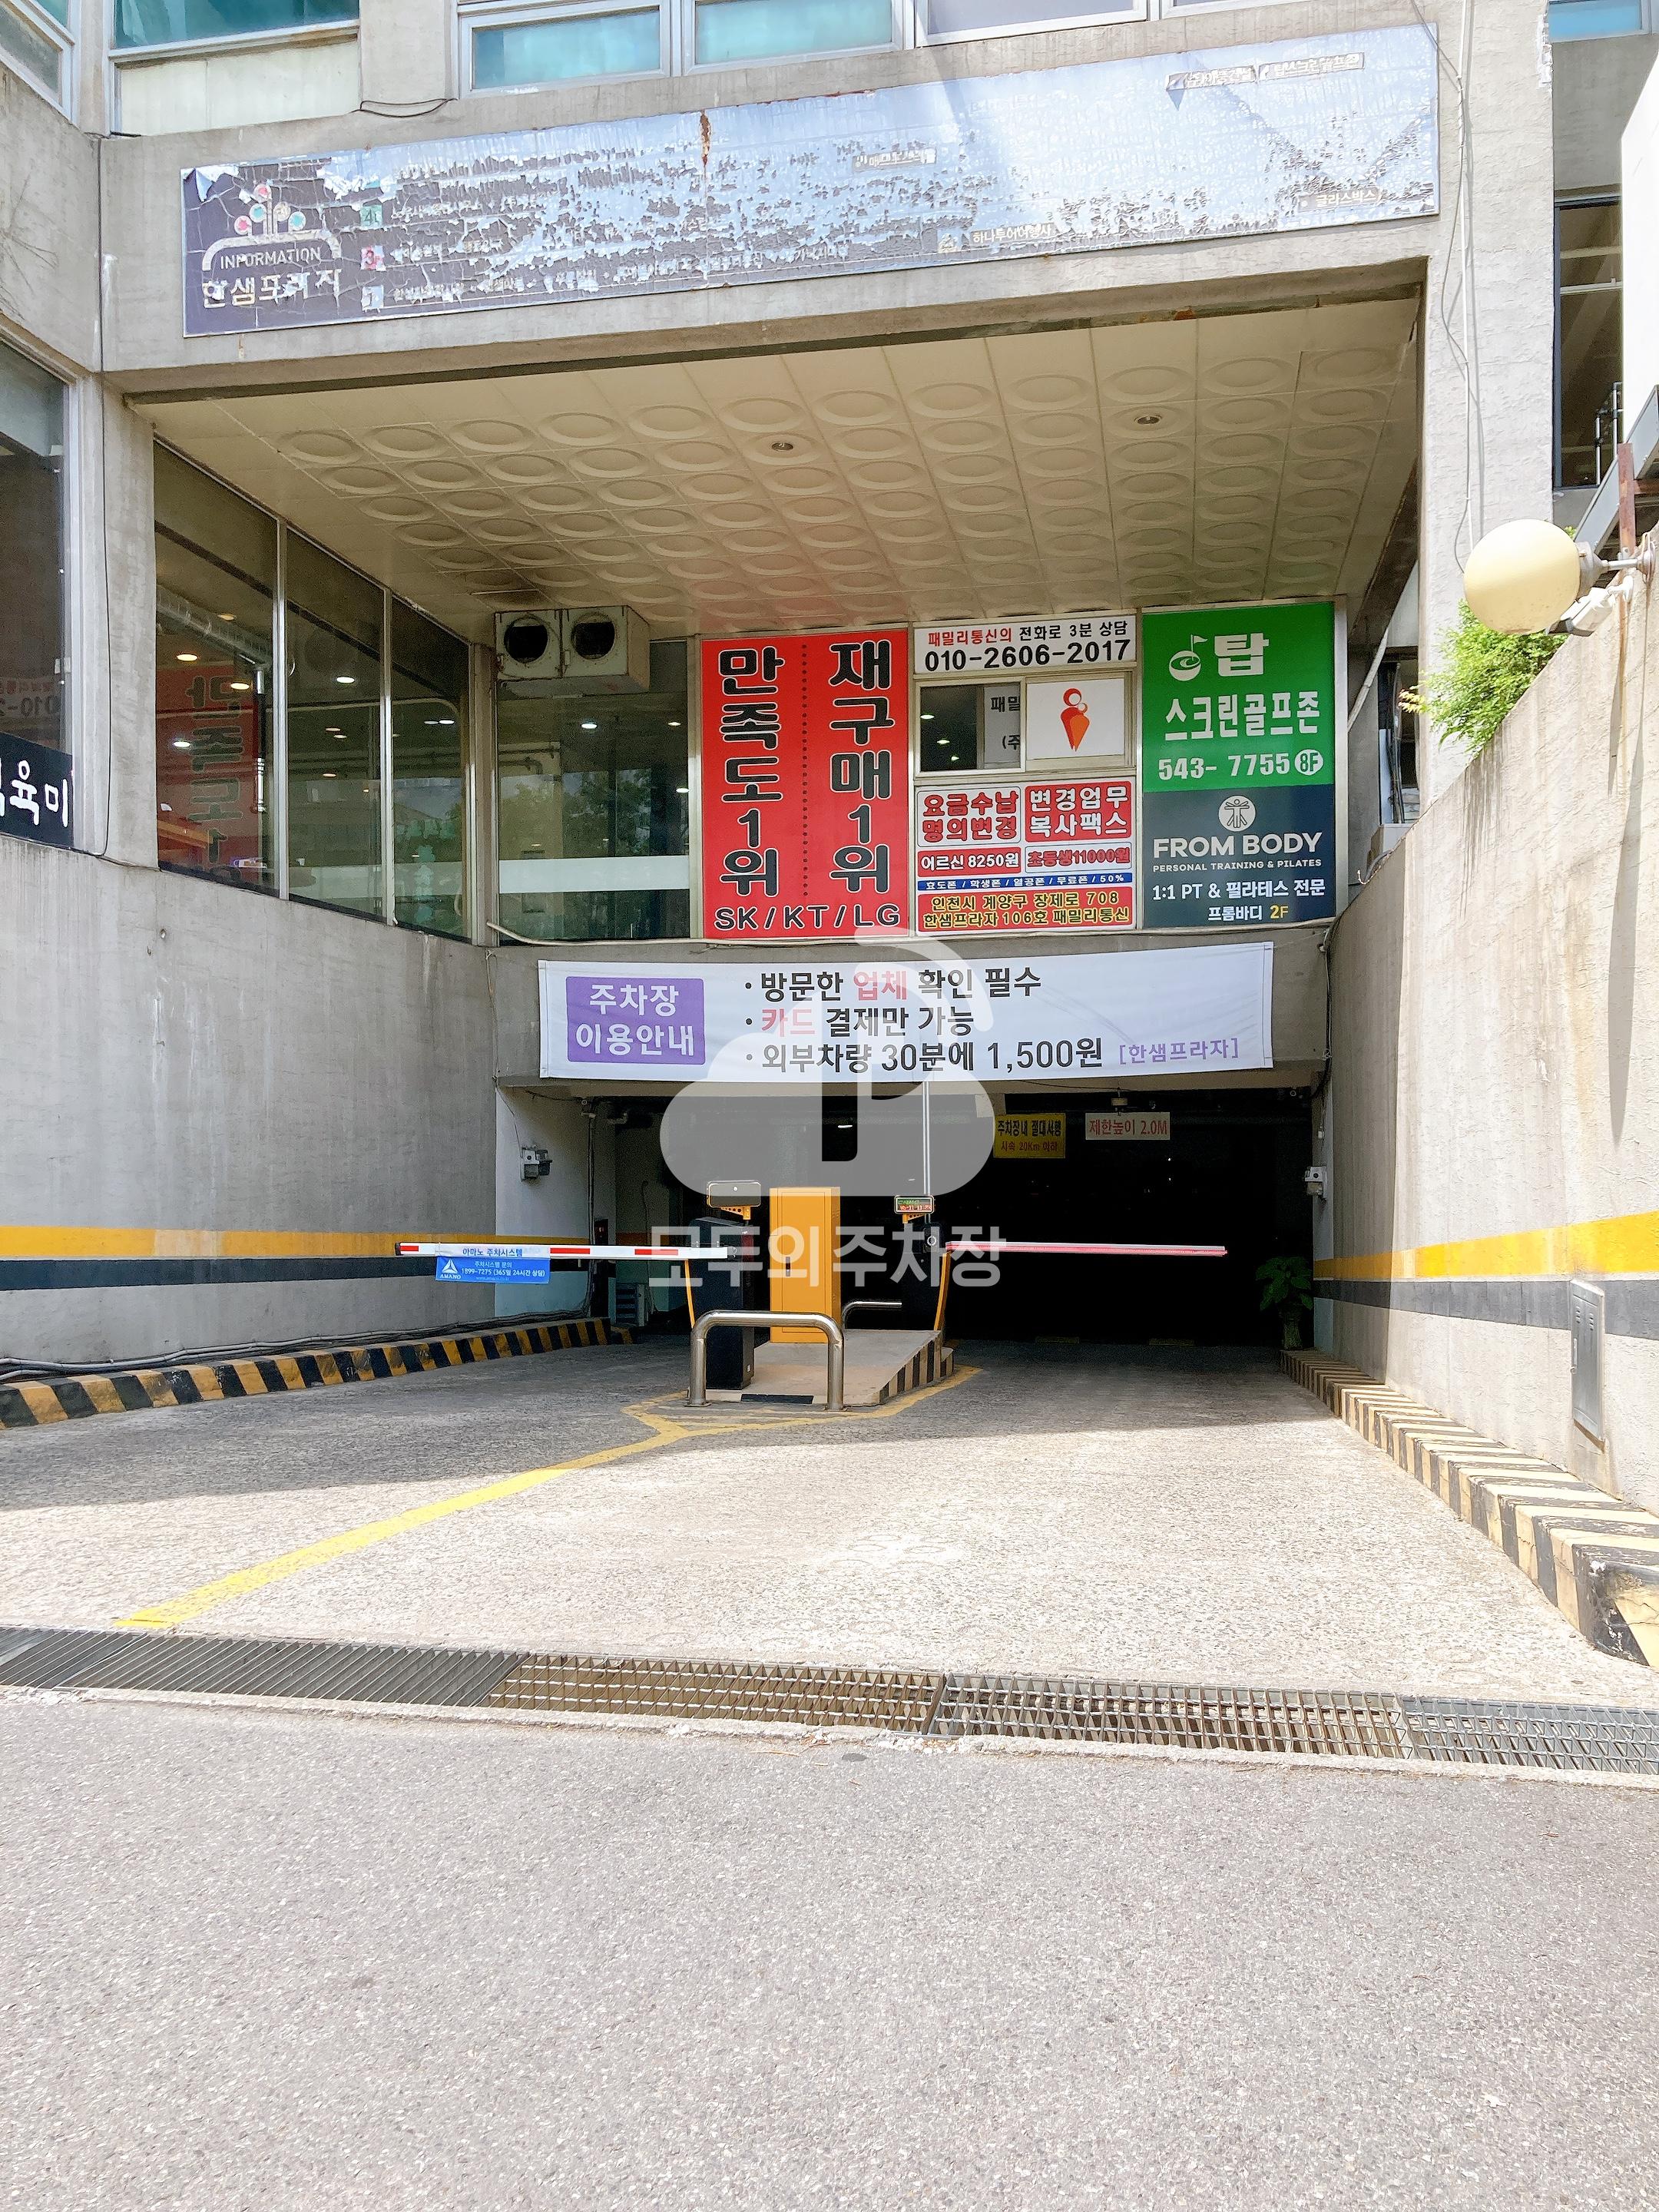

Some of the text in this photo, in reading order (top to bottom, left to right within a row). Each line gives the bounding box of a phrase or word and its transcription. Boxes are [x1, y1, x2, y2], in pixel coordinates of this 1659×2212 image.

[972, 223, 1052, 243] 하나투어여행사
[220, 247, 321, 270] INFORMATION
[928, 621, 1128, 647] 패밀리통신의 전화로 3분 상담
[925, 639, 1131, 672] 010-2606-2017
[1214, 633, 1269, 677] 탑
[1165, 691, 1320, 740] 스크린골프존
[1228, 753, 1290, 777] 7755
[1300, 753, 1319, 773] 8F
[0, 758, 68, 828] 육미
[922, 791, 1018, 817] 요금수납
[1030, 786, 1128, 813] 변경업무
[922, 816, 1017, 843] 명의변경
[1030, 812, 1127, 838] 복사팩스
[1153, 832, 1323, 859] FROM BODY
[921, 852, 1019, 871] 어르신 8250원
[1153, 859, 1322, 873] PERSONAL TRAINING & PILATES
[926, 880, 957, 889] 효도폰
[970, 878, 1001, 889] 학생폰
[1013, 877, 1045, 887] 열공폰
[1057, 876, 1088, 885] 무료폰
[1100, 874, 1124, 882] 50%
[1153, 879, 1326, 900] 1:1 PT & 필라테스 전문
[932, 892, 1119, 912] 인천시 계양구 장제로 708
[1208, 904, 1289, 922] 프롬바디 2F
[923, 906, 1130, 928] 한샘프라자 106호 패밀리통신
[761, 967, 1041, 1002] 방문한 업체 확인 필수
[589, 984, 679, 1017] 주차장
[761, 1006, 974, 1037] 카드 결제만 가능
[576, 1023, 694, 1056] 이용안내
[762, 1037, 1238, 1073] 외부차량 30분에 1,500원 [한샘프라자]
[998, 1120, 1028, 1137] 주차장내
[1089, 1119, 1168, 1136] 제한높이 2.0M
[1001, 1141, 1015, 1151] 시속
[1043, 1141, 1058, 1151] 이하
[462, 1248, 484, 1257] 아마노
[486, 1248, 523, 1257] 주차시스템
